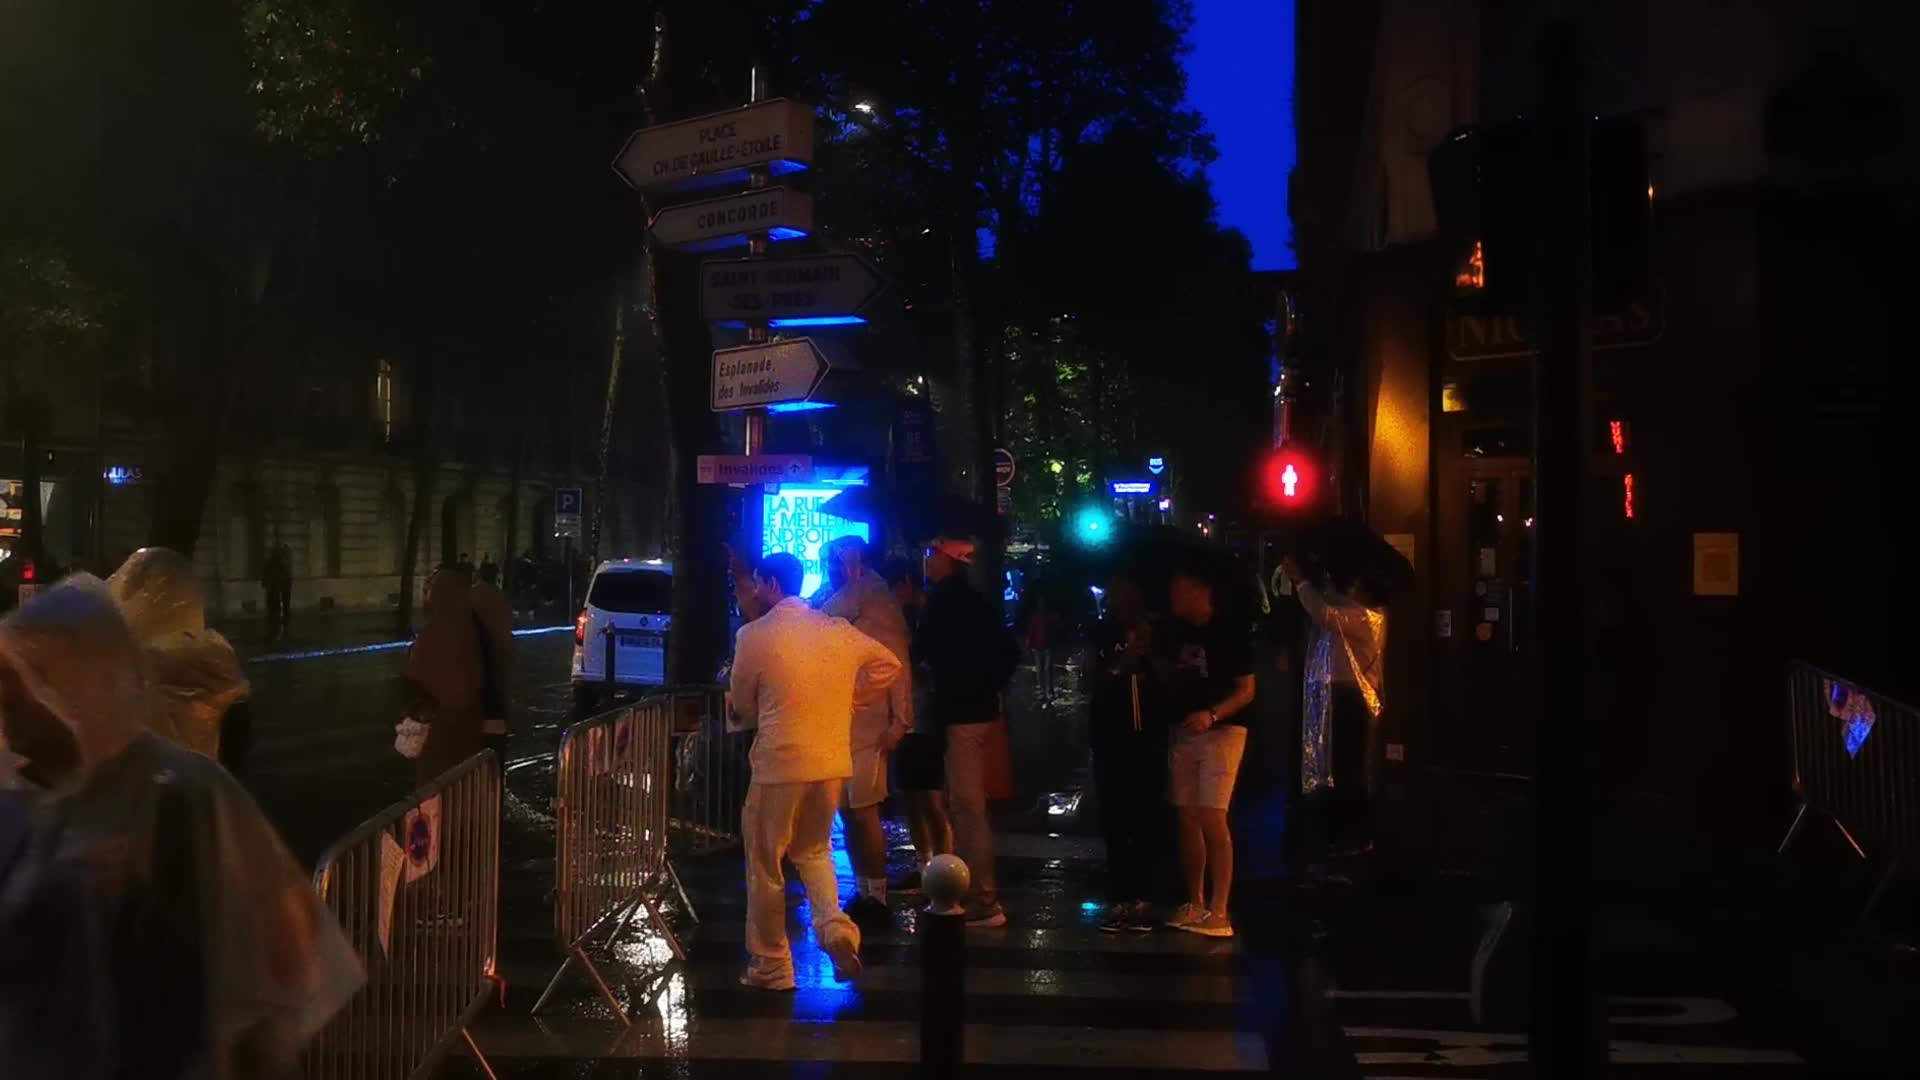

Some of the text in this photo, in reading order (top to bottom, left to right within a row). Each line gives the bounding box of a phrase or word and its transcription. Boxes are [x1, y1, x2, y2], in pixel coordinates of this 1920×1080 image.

[700, 122, 737, 143] PLACE
[697, 200, 779, 229] CONCORDE
[718, 379, 781, 400] des Invalides
[719, 462, 784, 476] Invalides
[562, 494, 574, 510] P
[769, 495, 790, 513] LA
[762, 528, 833, 543] ENDROIT
[762, 543, 807, 559] POUR
